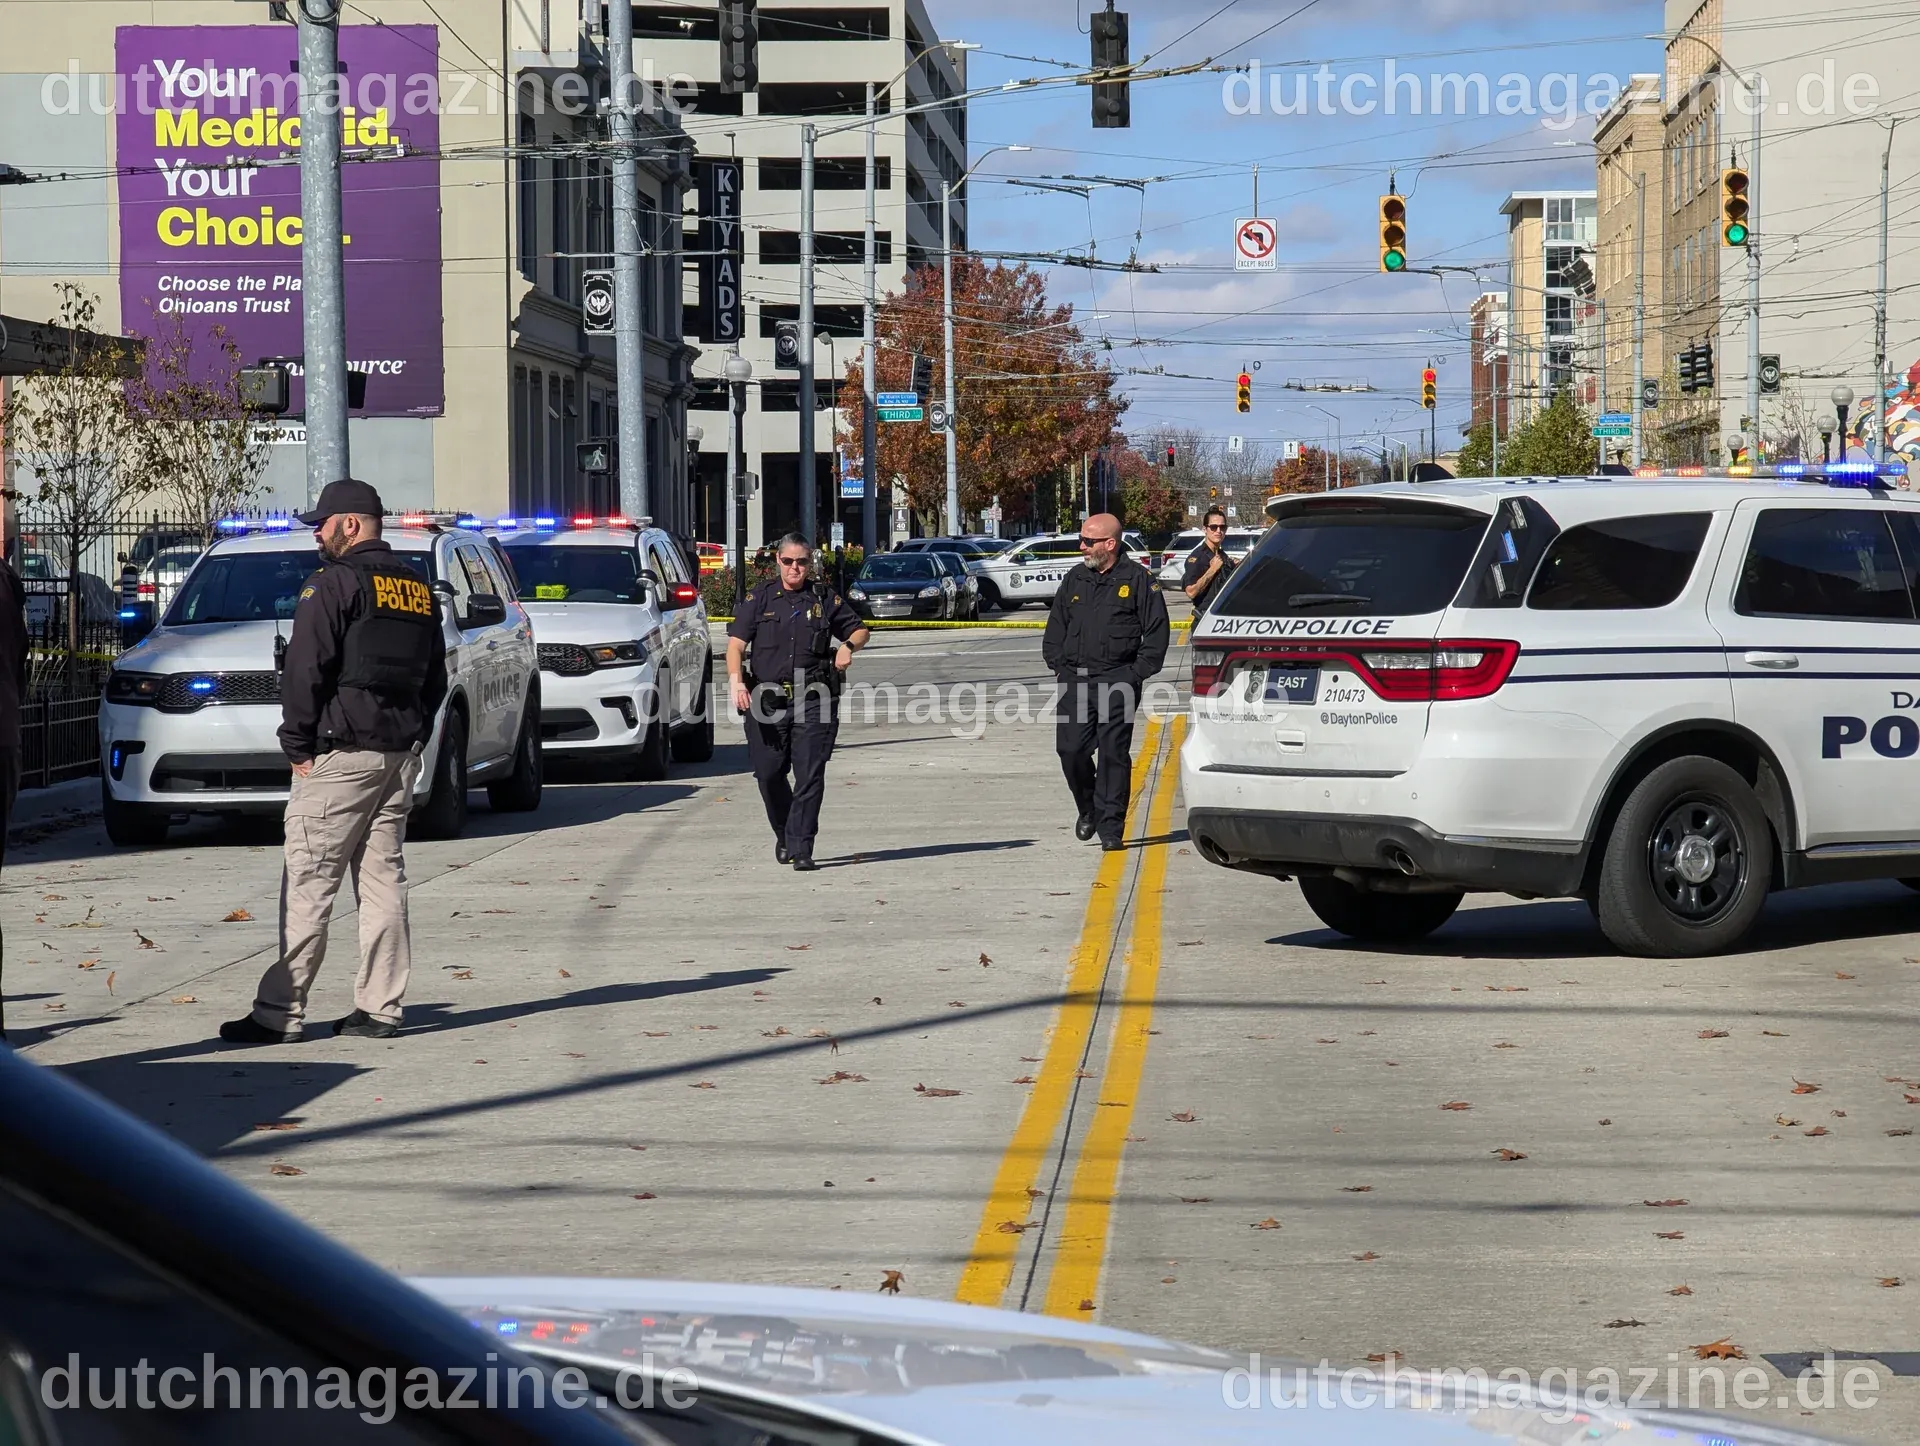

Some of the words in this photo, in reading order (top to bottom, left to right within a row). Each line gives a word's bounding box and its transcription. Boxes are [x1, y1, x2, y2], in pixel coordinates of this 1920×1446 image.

[153, 59, 256, 98] Your
[155, 107, 400, 147] Medicid.
[154, 158, 258, 197] Your
[156, 206, 351, 248] Choic.
[1237, 260, 1256, 268] EXCEPT
[1257, 260, 1274, 268] BUSES
[158, 276, 231, 292] Choose
[236, 276, 267, 291] the
[158, 298, 238, 314] Ohioans
[243, 298, 291, 313] Trust
[884, 411, 911, 419] THIRD
[1024, 573, 1067, 583] POLI
[373, 575, 430, 600] DAYTON
[376, 591, 432, 616] POLICE
[1211, 619, 1291, 635] DAYTON
[1289, 619, 1394, 635] POLICE
[483, 672, 519, 708] POLICE
[1277, 676, 1307, 689] EAST
[1324, 689, 1365, 702] 210473
[1320, 712, 1398, 727] @DaytonPolice
[1822, 715, 1920, 759] PO
